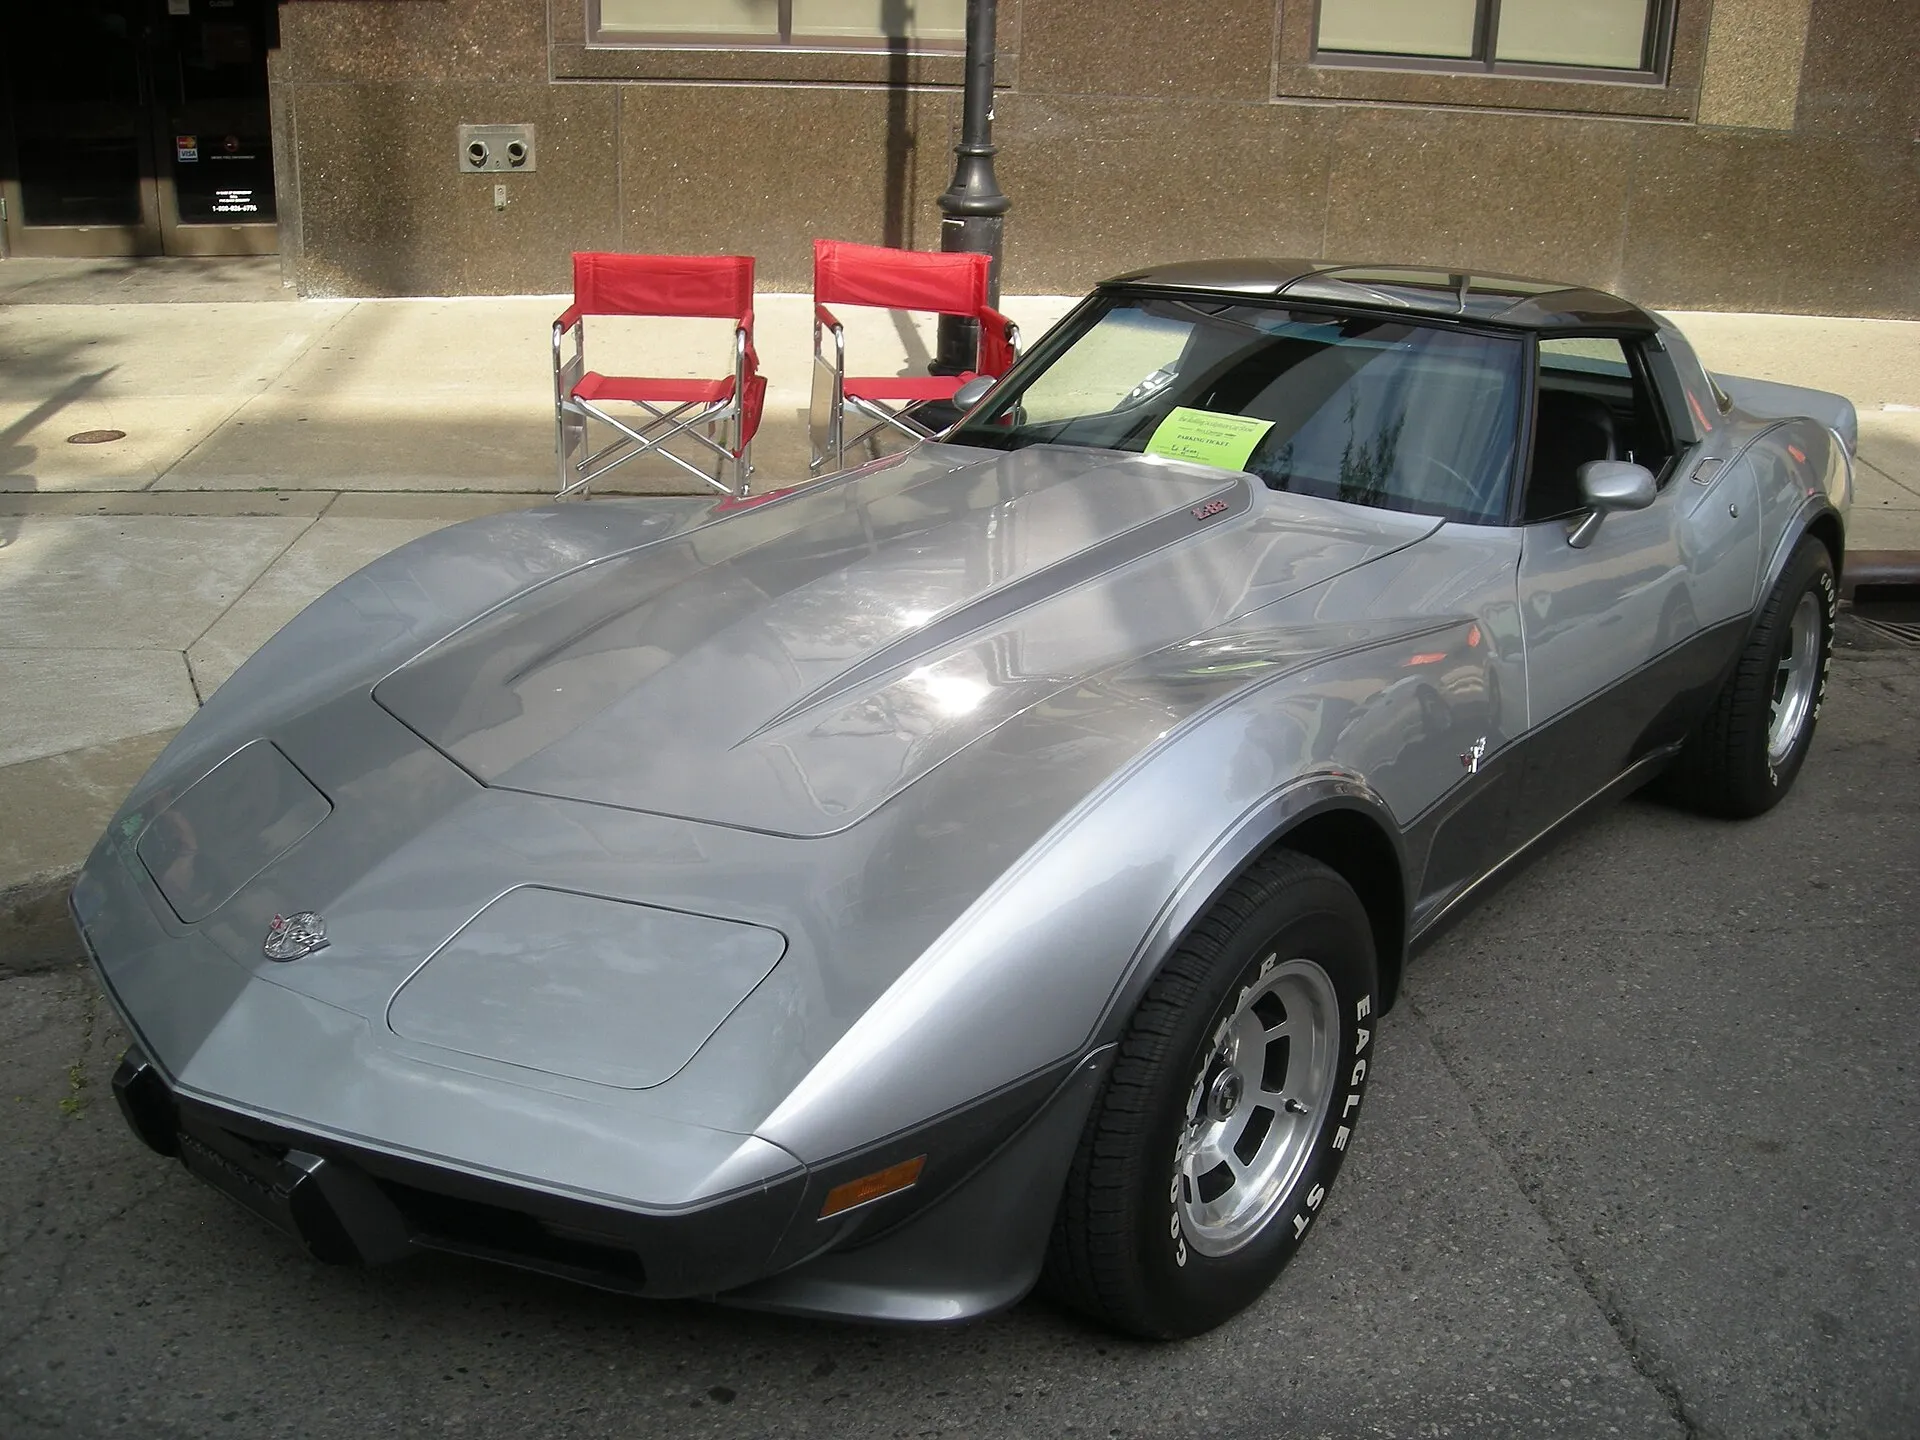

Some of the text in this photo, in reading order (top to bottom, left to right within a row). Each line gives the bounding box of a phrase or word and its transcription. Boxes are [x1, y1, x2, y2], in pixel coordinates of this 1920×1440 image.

[1177, 434, 1230, 447] PARKING TICKET
[1293, 994, 1371, 1240] EAGLE ST
